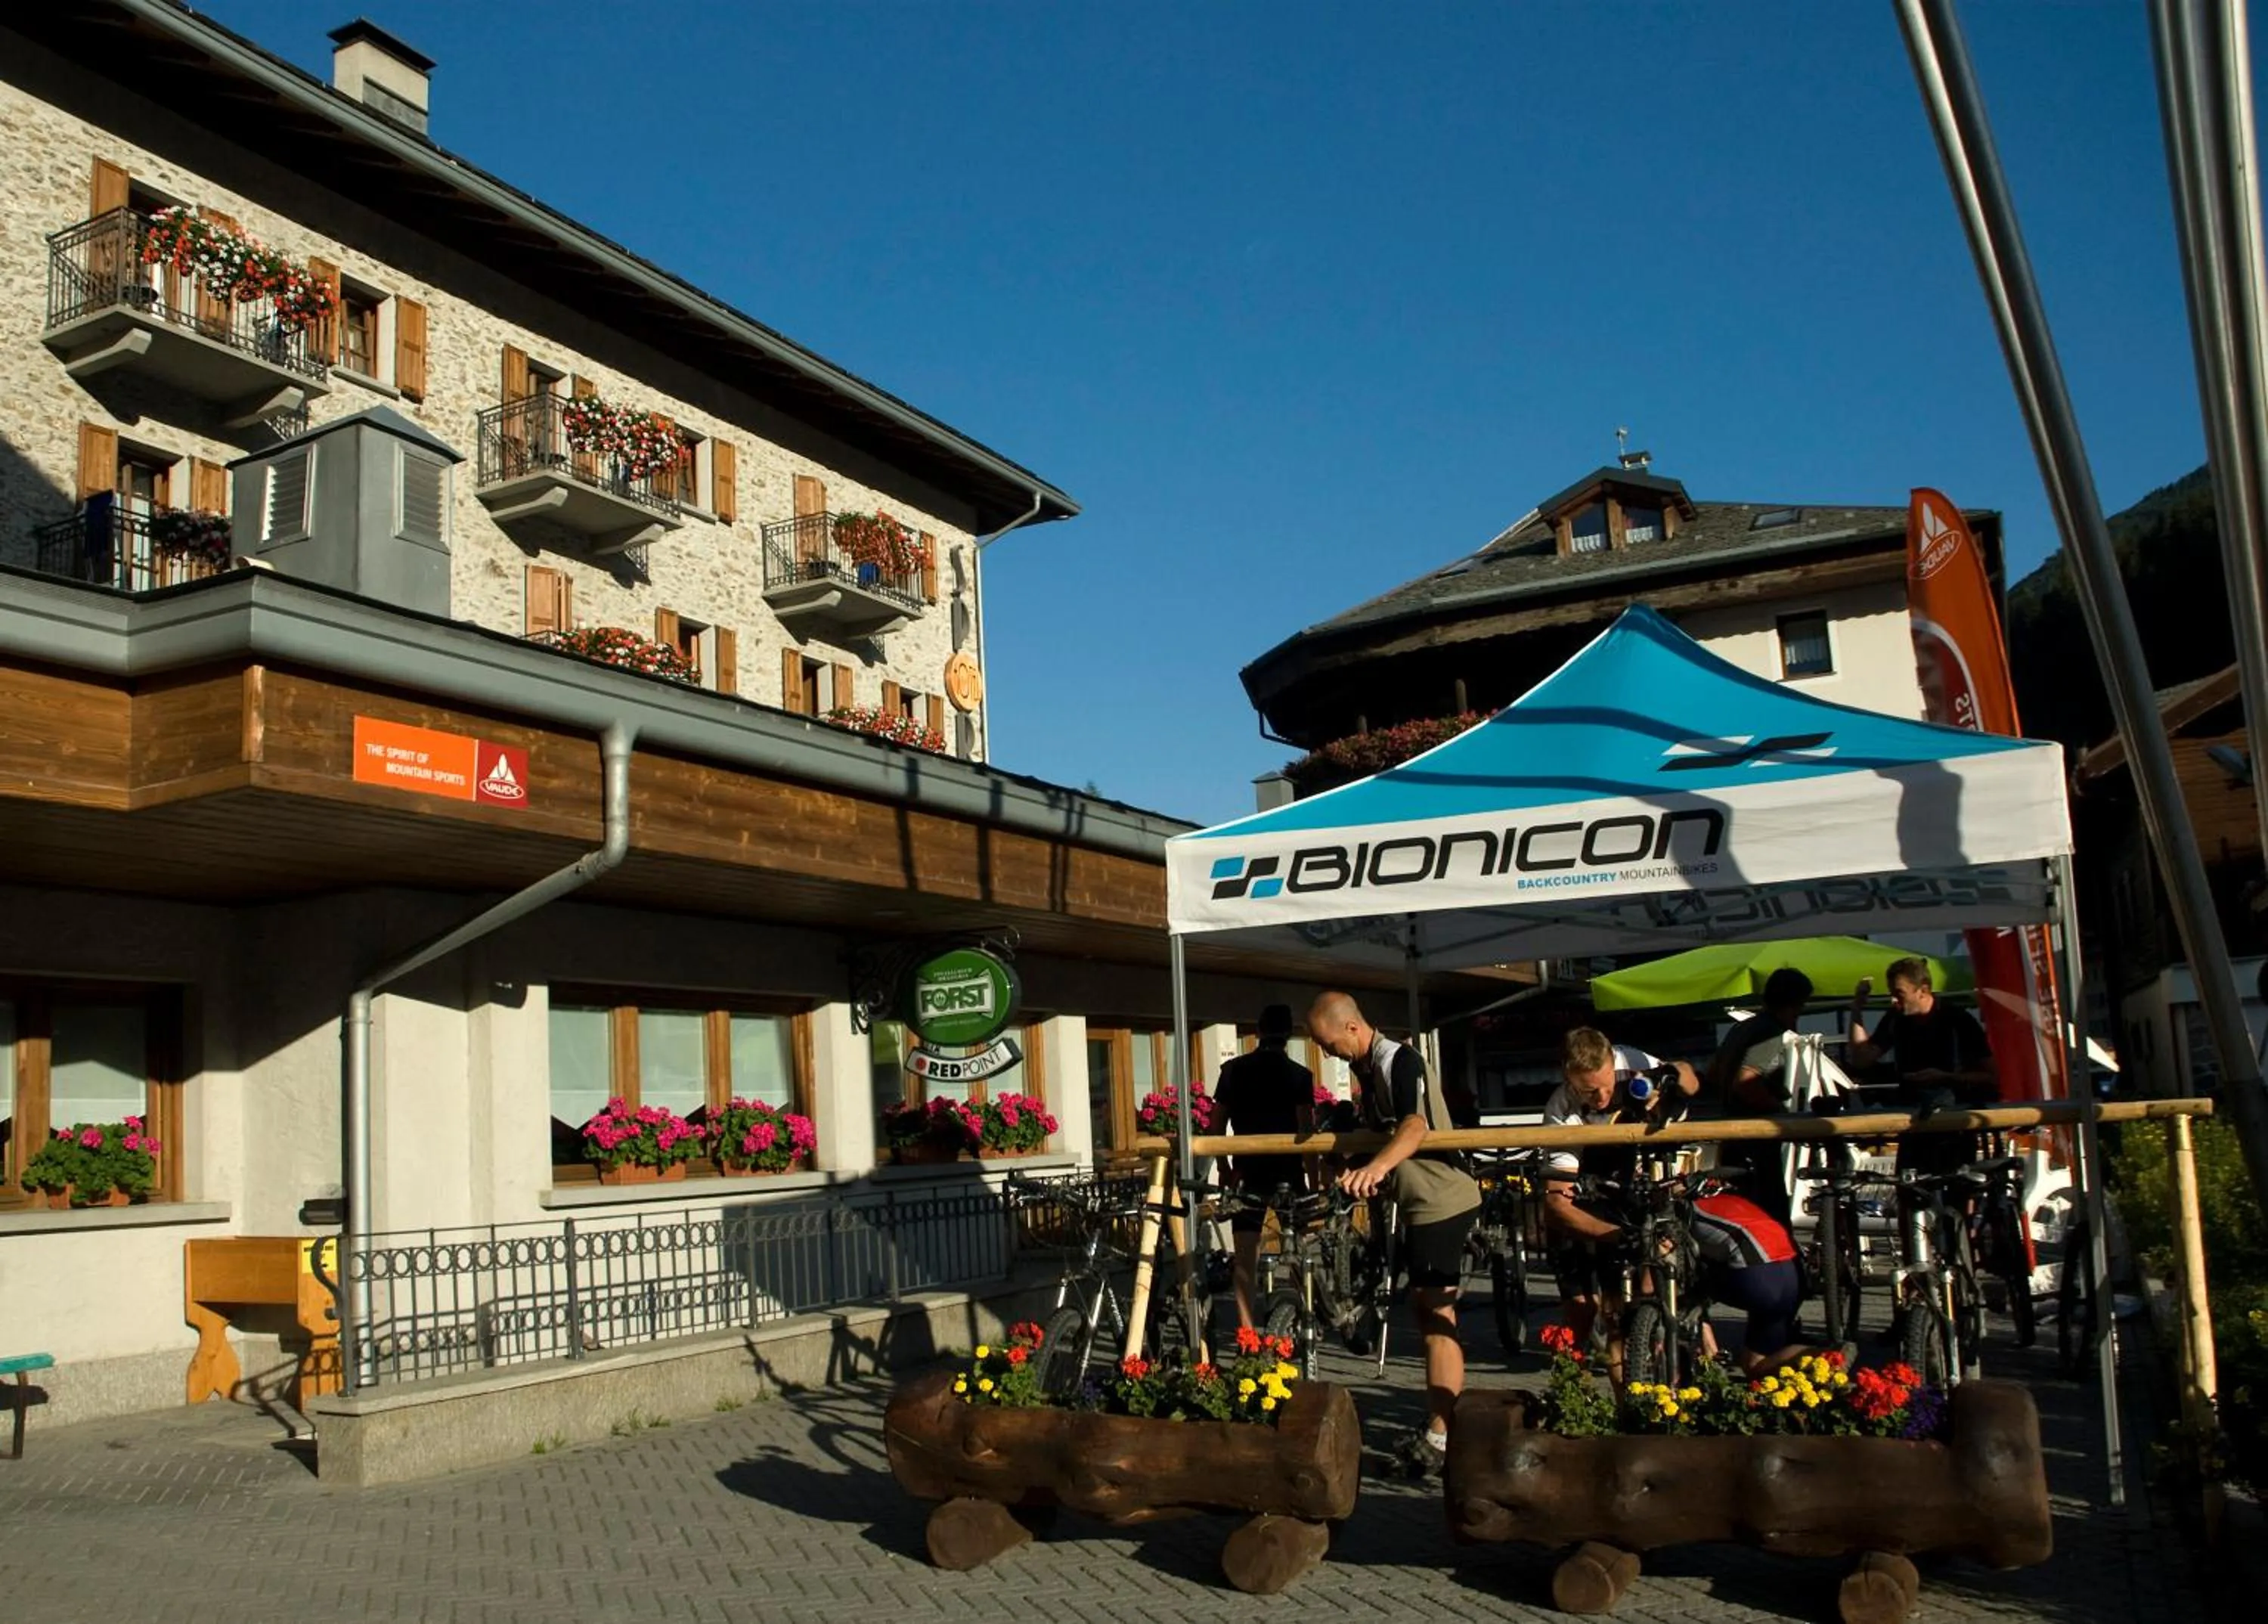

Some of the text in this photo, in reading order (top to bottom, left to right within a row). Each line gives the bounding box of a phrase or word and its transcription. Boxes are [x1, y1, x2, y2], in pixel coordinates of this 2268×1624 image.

[366, 743, 429, 764] THE SPIRIT OF
[386, 761, 466, 786] MOUNTAIN SPORTS
[485, 781, 519, 797] VAUDE
[1286, 807, 1724, 894] BIONICON
[1517, 861, 1718, 890] BACKCOUNTRY MOUNTAINBIKES
[920, 983, 989, 1013] FORST
